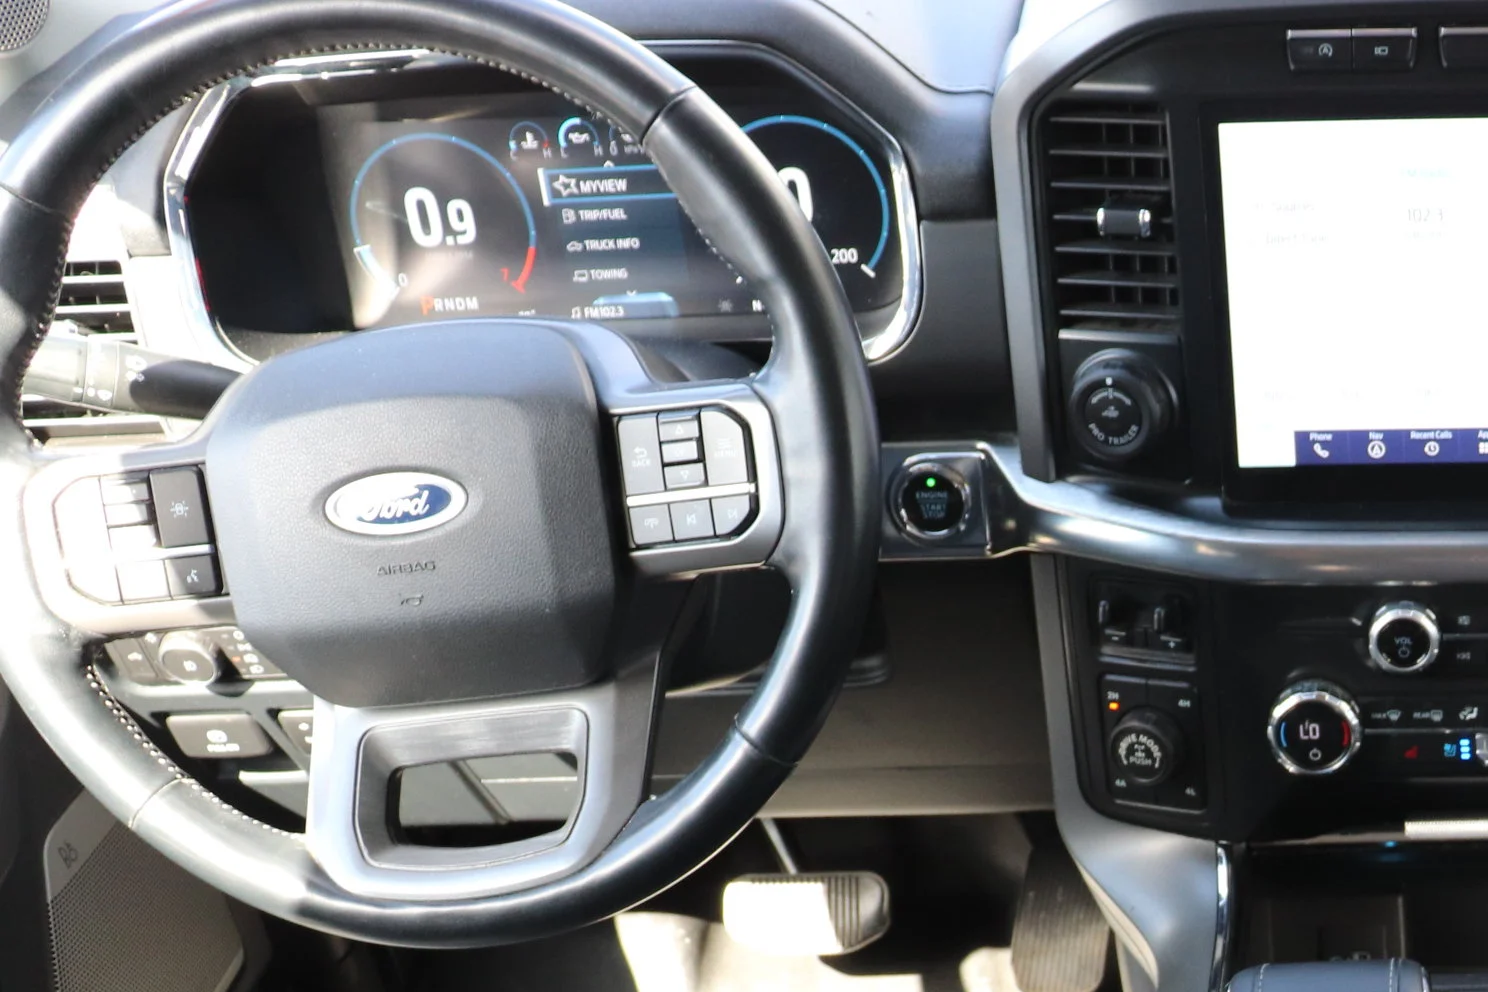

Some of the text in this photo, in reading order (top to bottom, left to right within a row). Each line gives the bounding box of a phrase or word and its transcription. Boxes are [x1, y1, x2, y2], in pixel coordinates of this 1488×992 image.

[580, 178, 628, 194] MYVIEW
[403, 187, 477, 247] 0.9
[578, 208, 628, 221] TRIP/FUEL
[584, 237, 641, 252] TRUCK INFO
[831, 248, 859, 264] 200
[590, 268, 629, 281] TOWING
[1088, 422, 1139, 445] PRO TRAILER
[1309, 432, 1333, 442] Phone
[1369, 431, 1384, 441] Nav
[1410, 430, 1453, 440] Recent Calls
[915, 491, 948, 500] ENGINE
[377, 561, 437, 576] AIRBAG
[1394, 637, 1413, 646] VOL
[1129, 755, 1152, 767] PUSH
